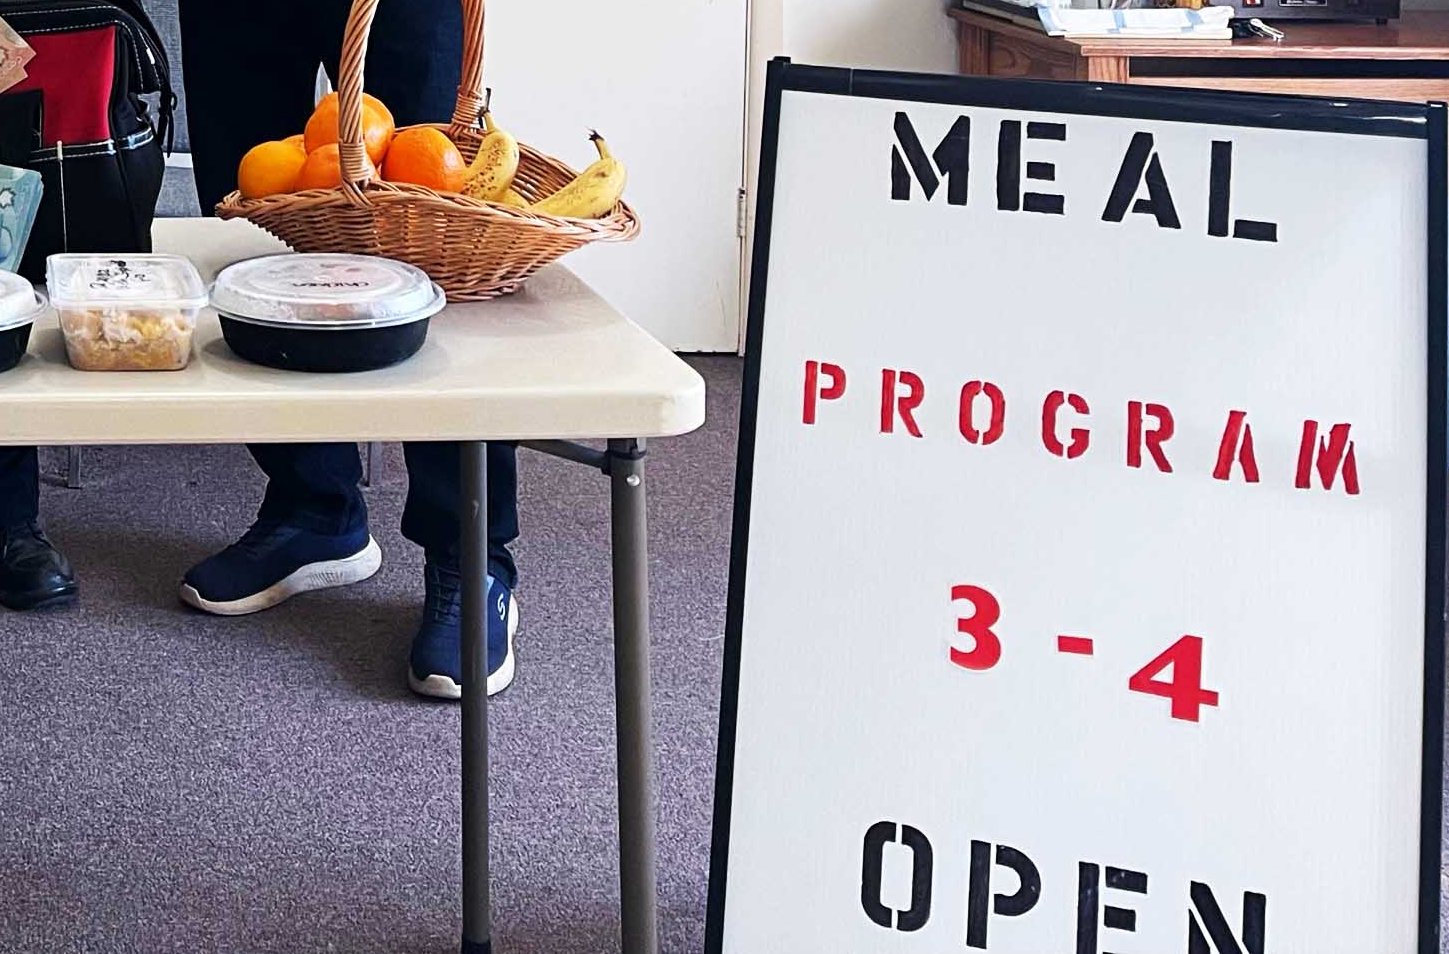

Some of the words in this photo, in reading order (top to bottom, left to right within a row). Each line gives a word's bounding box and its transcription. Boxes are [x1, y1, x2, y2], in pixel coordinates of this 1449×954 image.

[891, 111, 1278, 243] MEAL
[802, 360, 1361, 496] PROGRAM
[950, 584, 1002, 670] 3
[1057, 635, 1094, 656] -
[1128, 634, 1219, 723] 4
[860, 820, 1268, 954] OPEN
